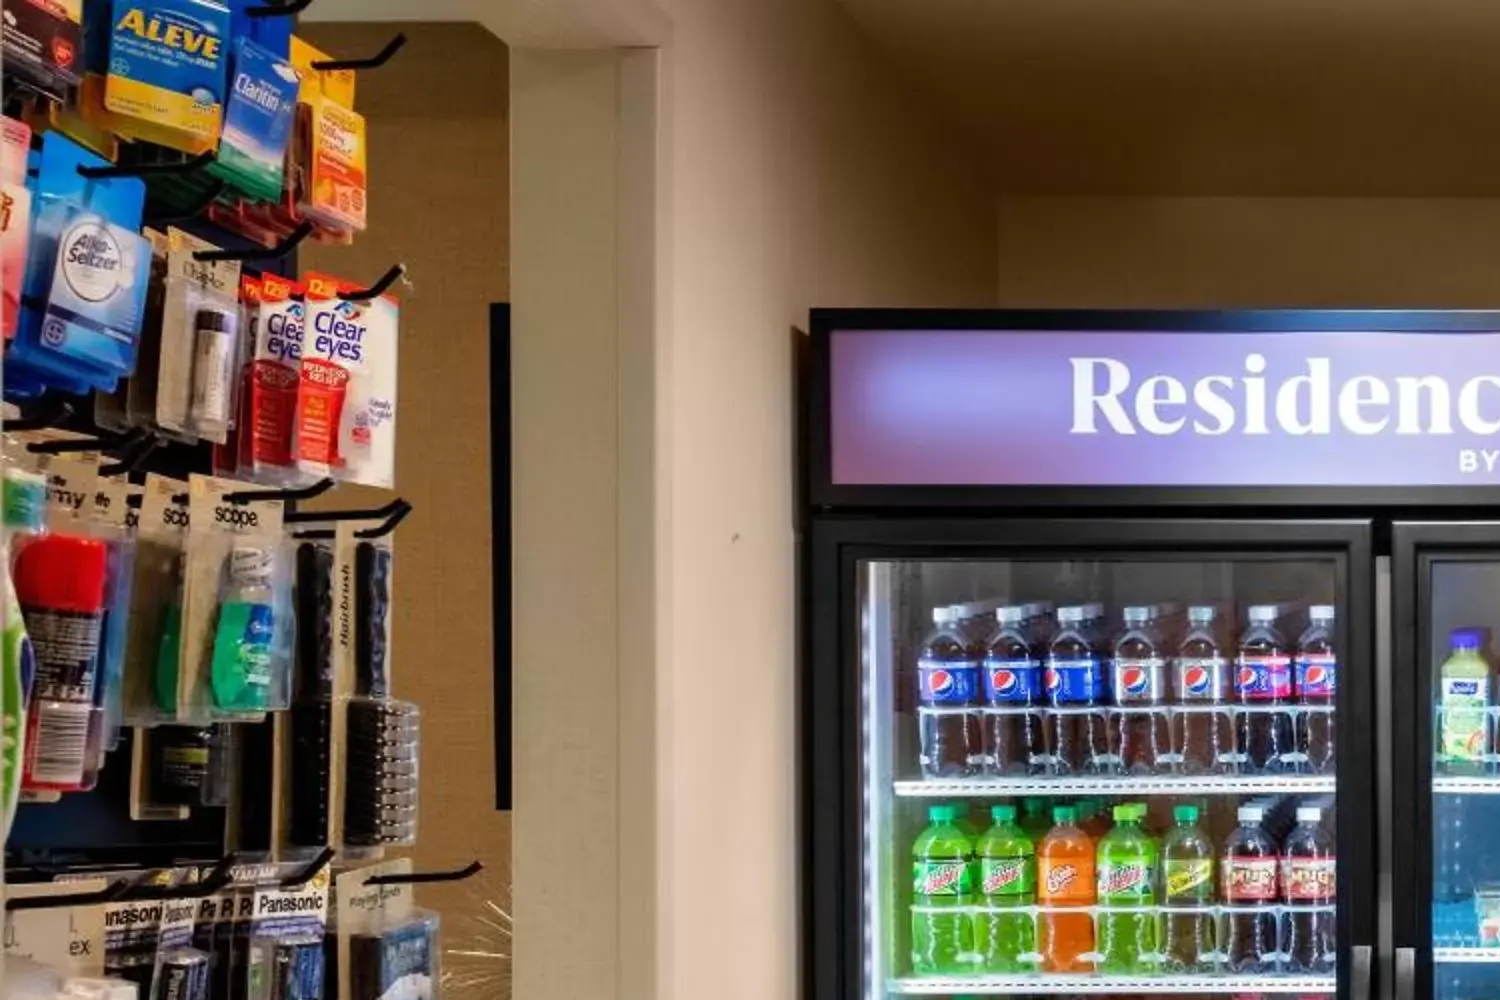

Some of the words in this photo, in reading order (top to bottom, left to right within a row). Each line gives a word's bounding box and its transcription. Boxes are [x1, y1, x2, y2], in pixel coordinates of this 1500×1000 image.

[117, 8, 221, 60] ALEVE
[235, 73, 279, 112] Claritin
[67, 246, 118, 271] Seltzer
[315, 310, 366, 342] Clear
[315, 335, 362, 362] eyes
[1459, 448, 1500, 473] BY
[214, 506, 258, 528] scope
[259, 891, 323, 914] Panasonic
